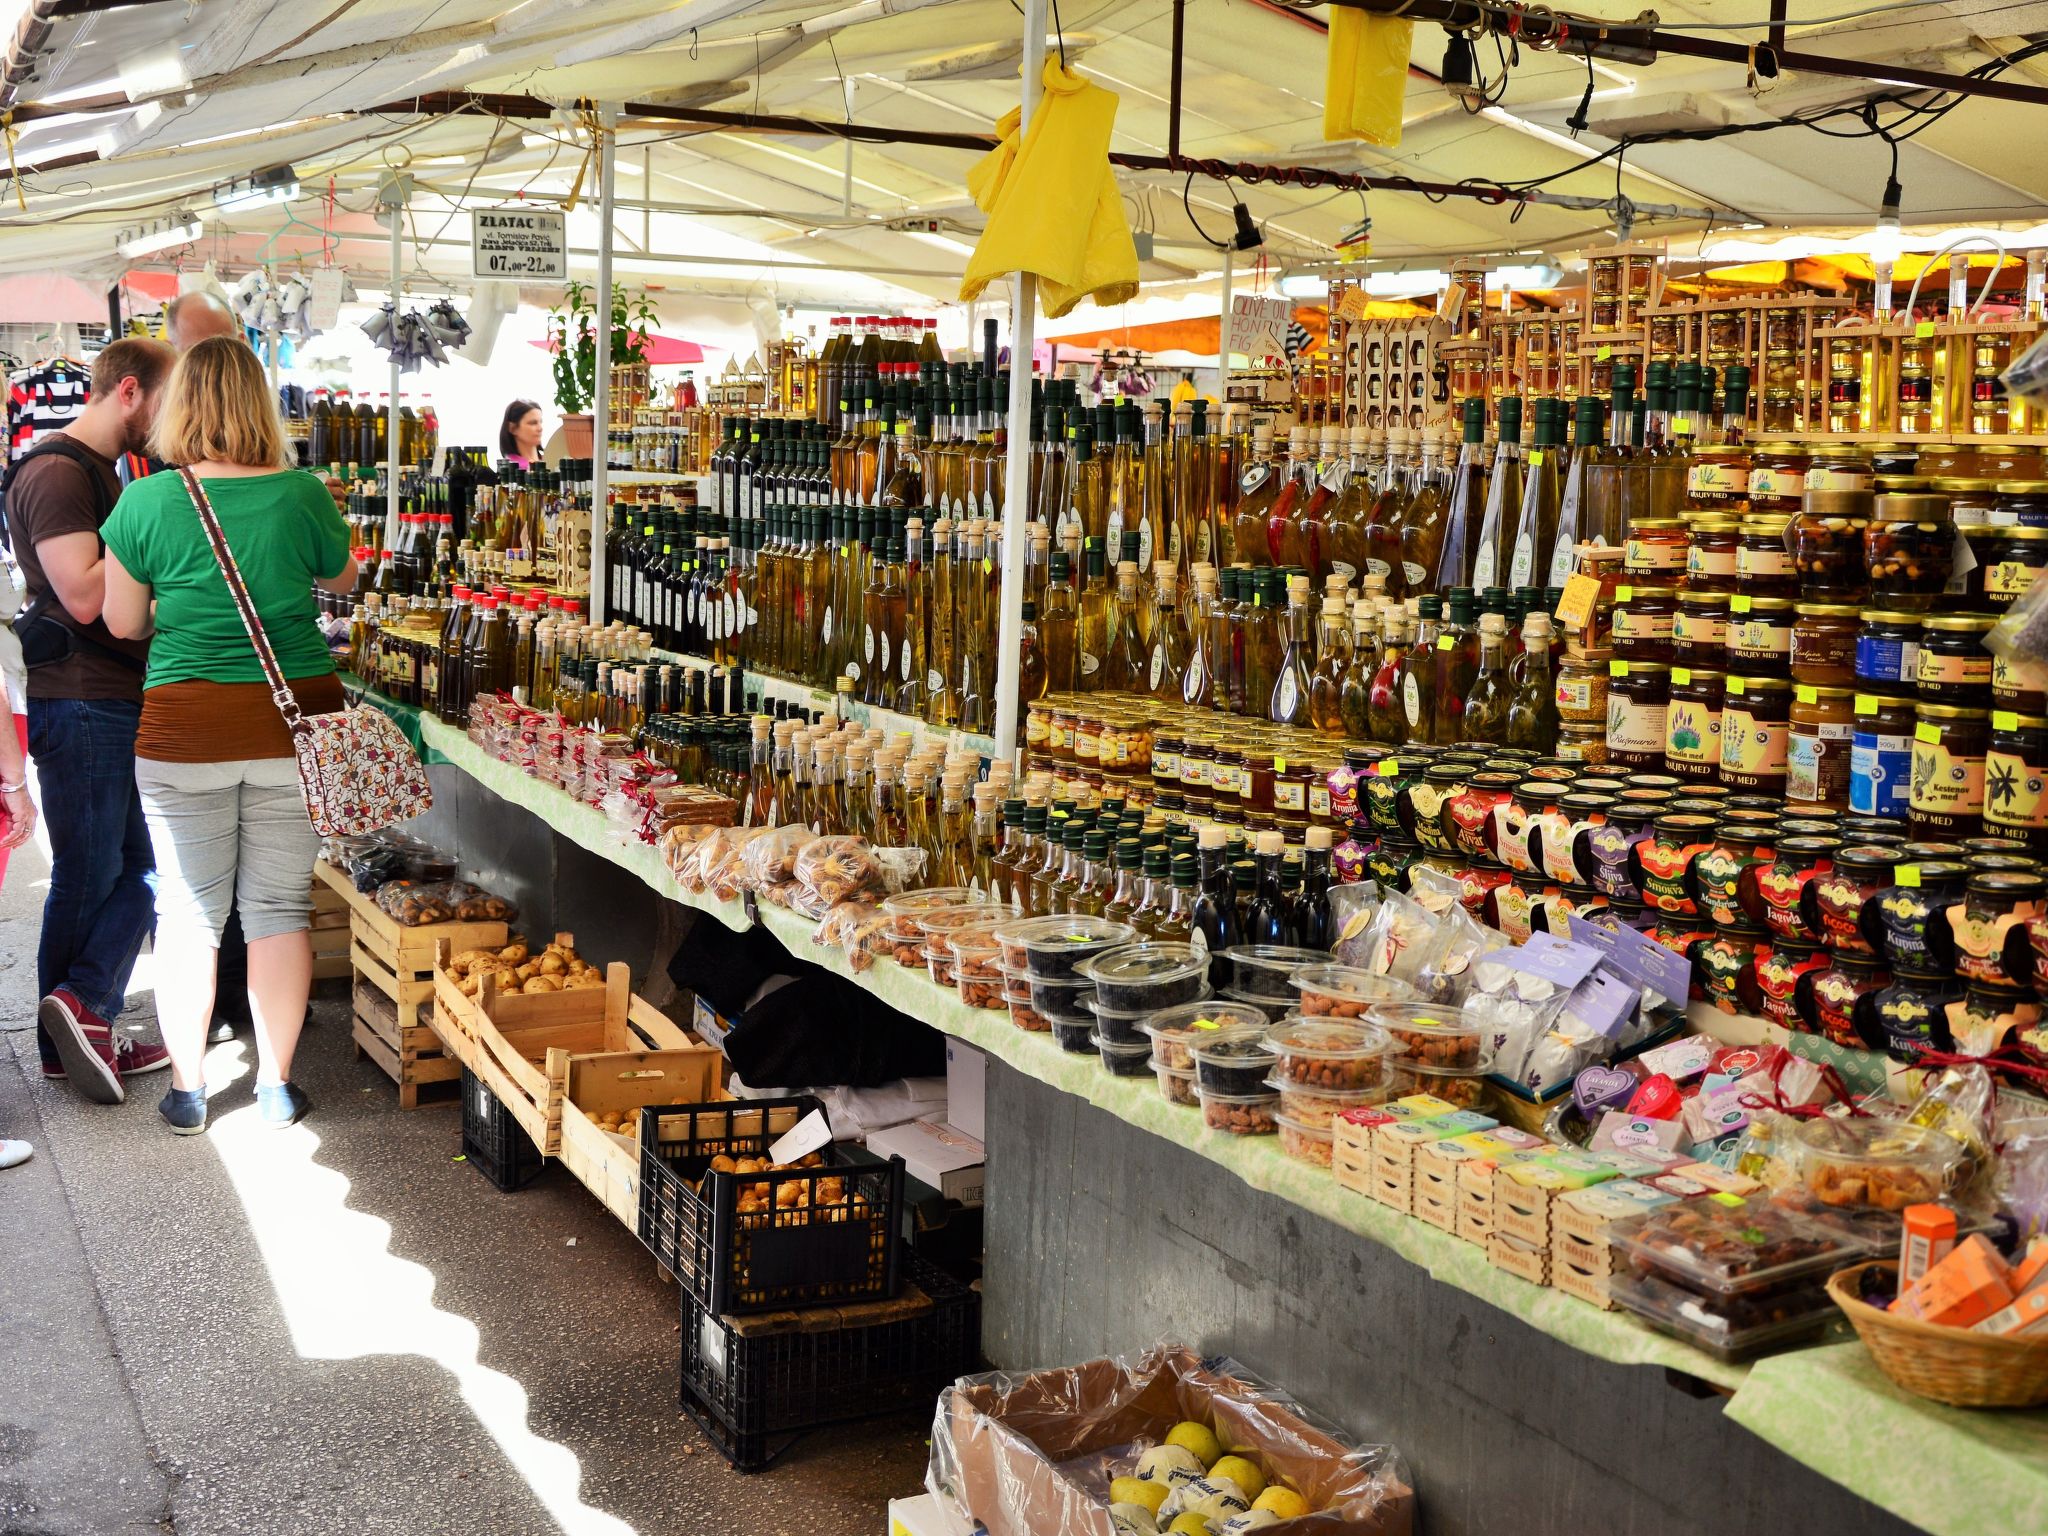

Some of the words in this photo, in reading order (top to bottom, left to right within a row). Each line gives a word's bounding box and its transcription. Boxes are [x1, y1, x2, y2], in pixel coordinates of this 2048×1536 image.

[480, 216, 534, 228] ZLATAC
[1234, 296, 1267, 319] OLIVE
[1273, 302, 1287, 320] OIL
[1735, 650, 1761, 659] KRALJEV
[1762, 651, 1778, 659] MED
[1926, 682, 1941, 690] MED
[1690, 765, 1711, 774] MED
[1737, 775, 1757, 785] MED
[1933, 783, 1970, 794] Kestenov
[1940, 793, 1959, 801] med
[1332, 801, 1358, 815] Aronija
[1371, 810, 1397, 825] Maslina
[1930, 814, 1953, 826] MED
[1417, 820, 1441, 836] Maslina
[2004, 828, 2028, 839] MED
[1458, 828, 1484, 847] Ajvar
[1499, 838, 1527, 856] Smokva
[1545, 849, 1572, 866] Smokva
[1599, 865, 1624, 883] Šljiva
[1646, 877, 1684, 895] Smokva
[1700, 893, 1738, 908] Mandarina
[1767, 906, 1802, 924] Jagoda
[1502, 919, 1529, 936] Smokva
[1887, 928, 1926, 951] Kupina
[1763, 996, 1796, 1016] Jagoda
[1585, 1076, 1619, 1087] LAVANDA
[1559, 1239, 1600, 1265] CROATIA
[1497, 1251, 1531, 1270] TROGIR
